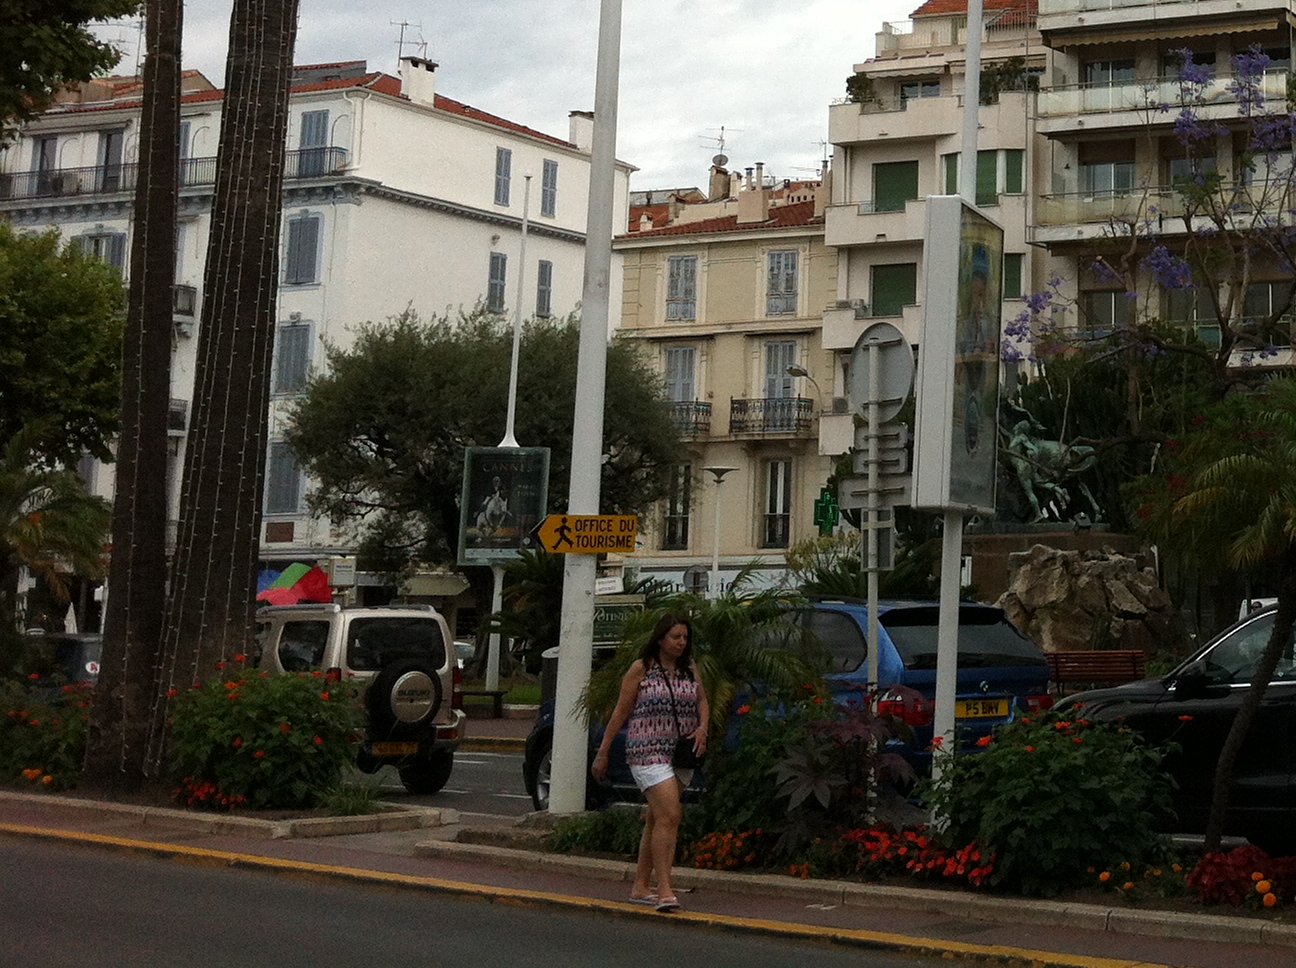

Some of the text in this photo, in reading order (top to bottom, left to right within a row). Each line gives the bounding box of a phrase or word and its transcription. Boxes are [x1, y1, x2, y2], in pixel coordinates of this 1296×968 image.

[574, 519, 635, 532] OFFICE DU
[575, 535, 633, 548] TOURISME
